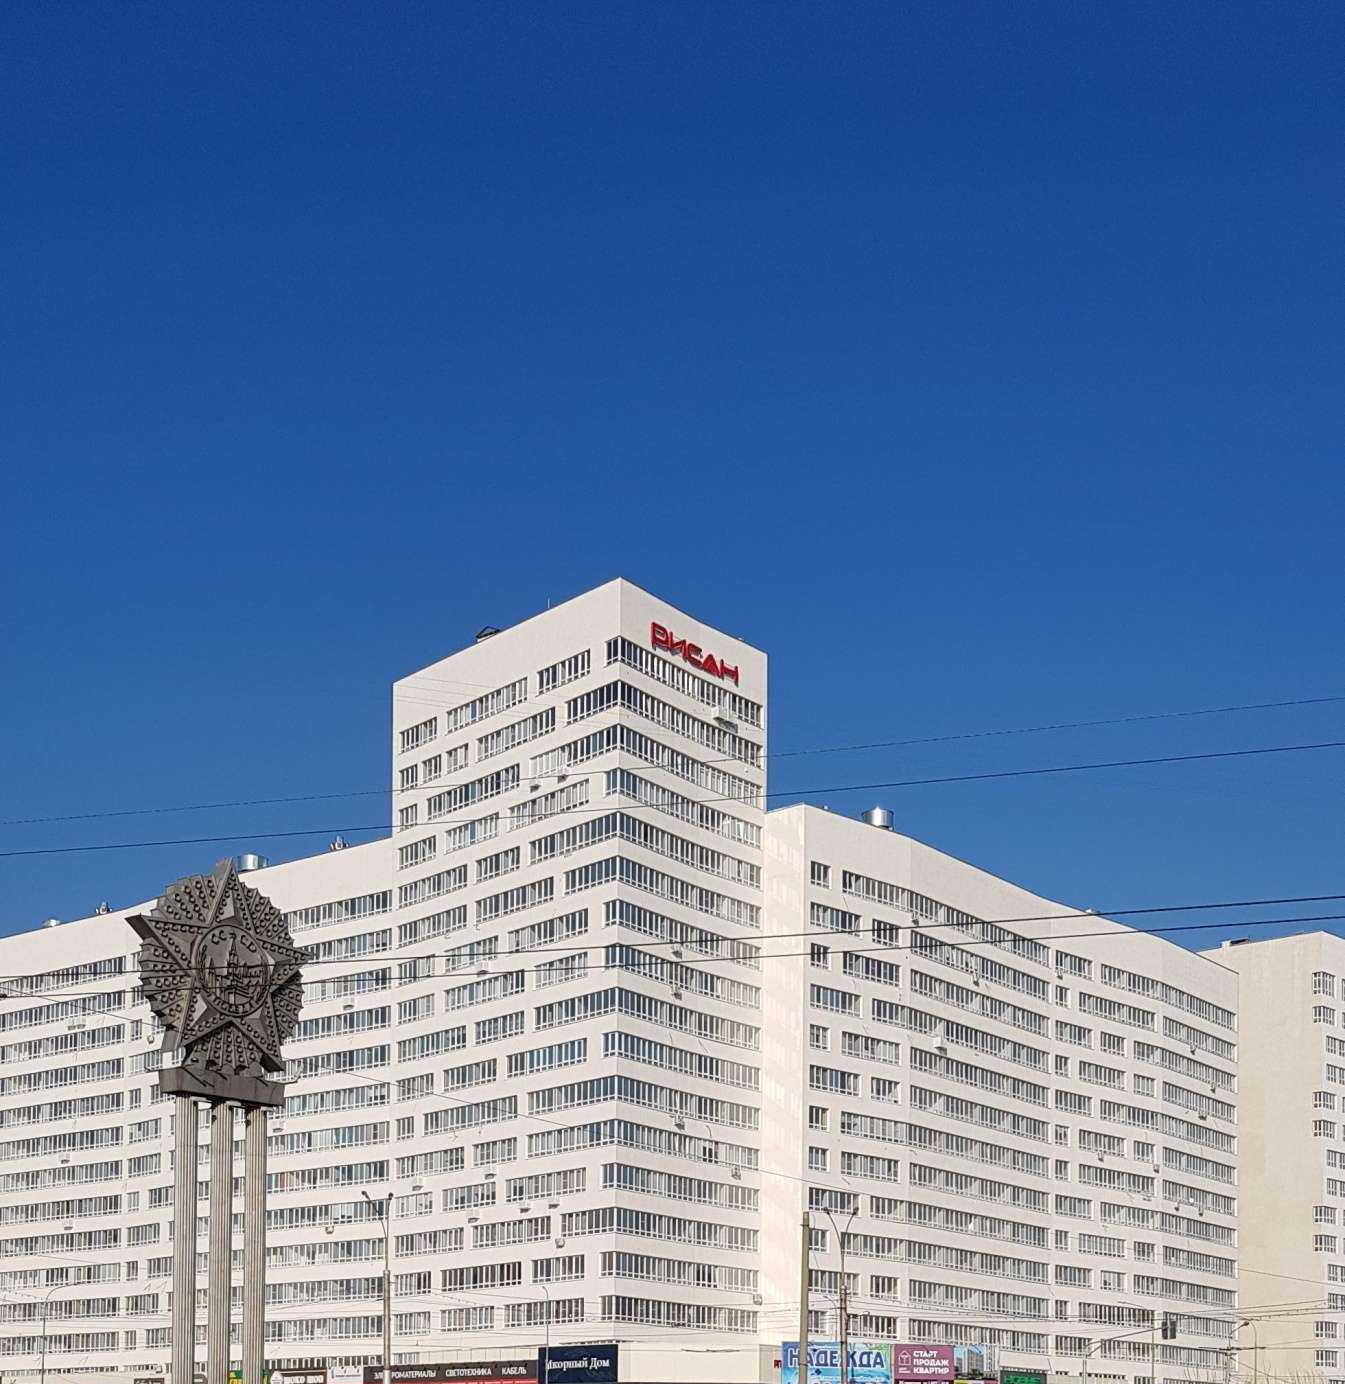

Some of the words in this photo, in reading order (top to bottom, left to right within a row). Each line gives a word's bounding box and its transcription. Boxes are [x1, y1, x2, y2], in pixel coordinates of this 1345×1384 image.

[589, 1357, 610, 1369] Дом
[445, 1367, 492, 1377] СВЕТОТЕХНИКА
[502, 1366, 527, 1375] КАБЕЛЬ
